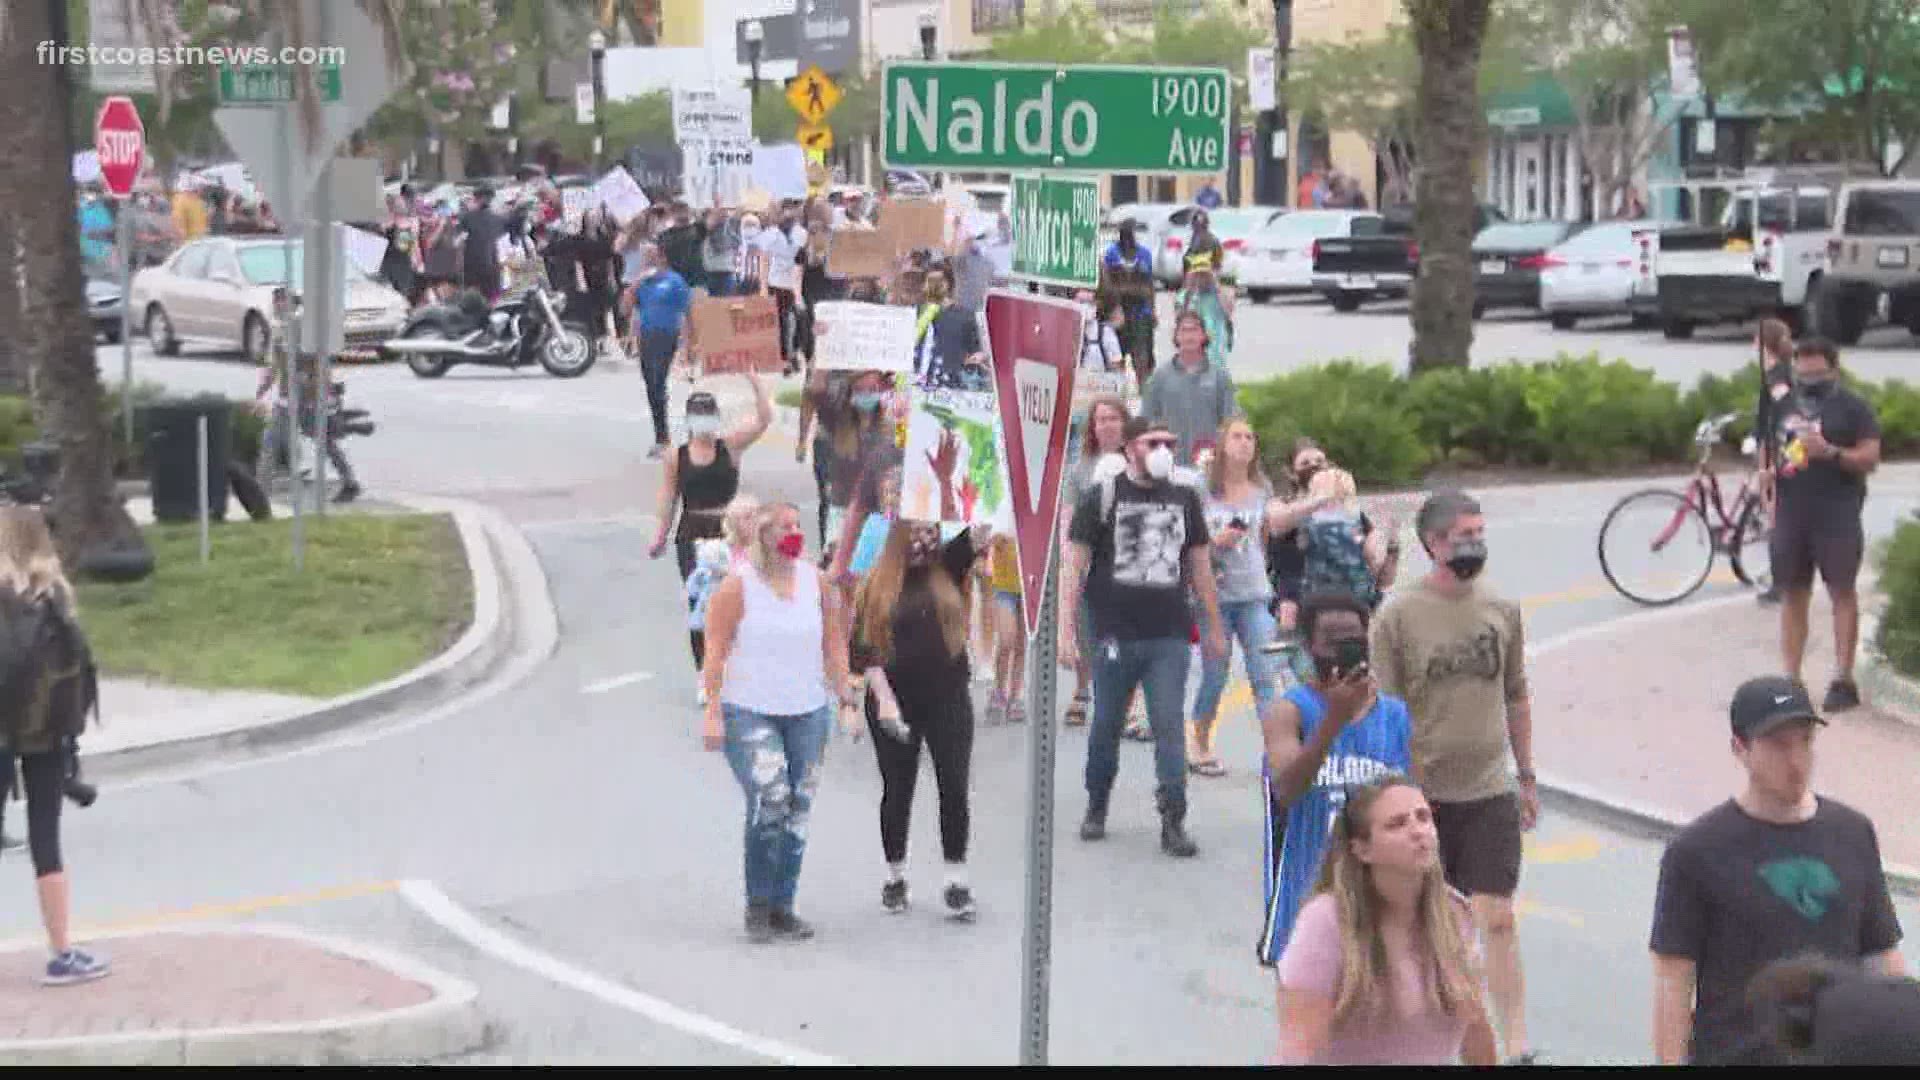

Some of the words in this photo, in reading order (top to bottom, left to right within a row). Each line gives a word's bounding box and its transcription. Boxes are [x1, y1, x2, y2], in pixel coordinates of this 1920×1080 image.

[895, 77, 1098, 156] Naldo
[1151, 77, 1221, 118] 1900
[101, 131, 141, 165] STOP
[1167, 127, 1218, 167] Ave
[1026, 189, 1070, 268] Marco
[1072, 188, 1097, 228] 1900
[1022, 382, 1051, 425] YIELD
